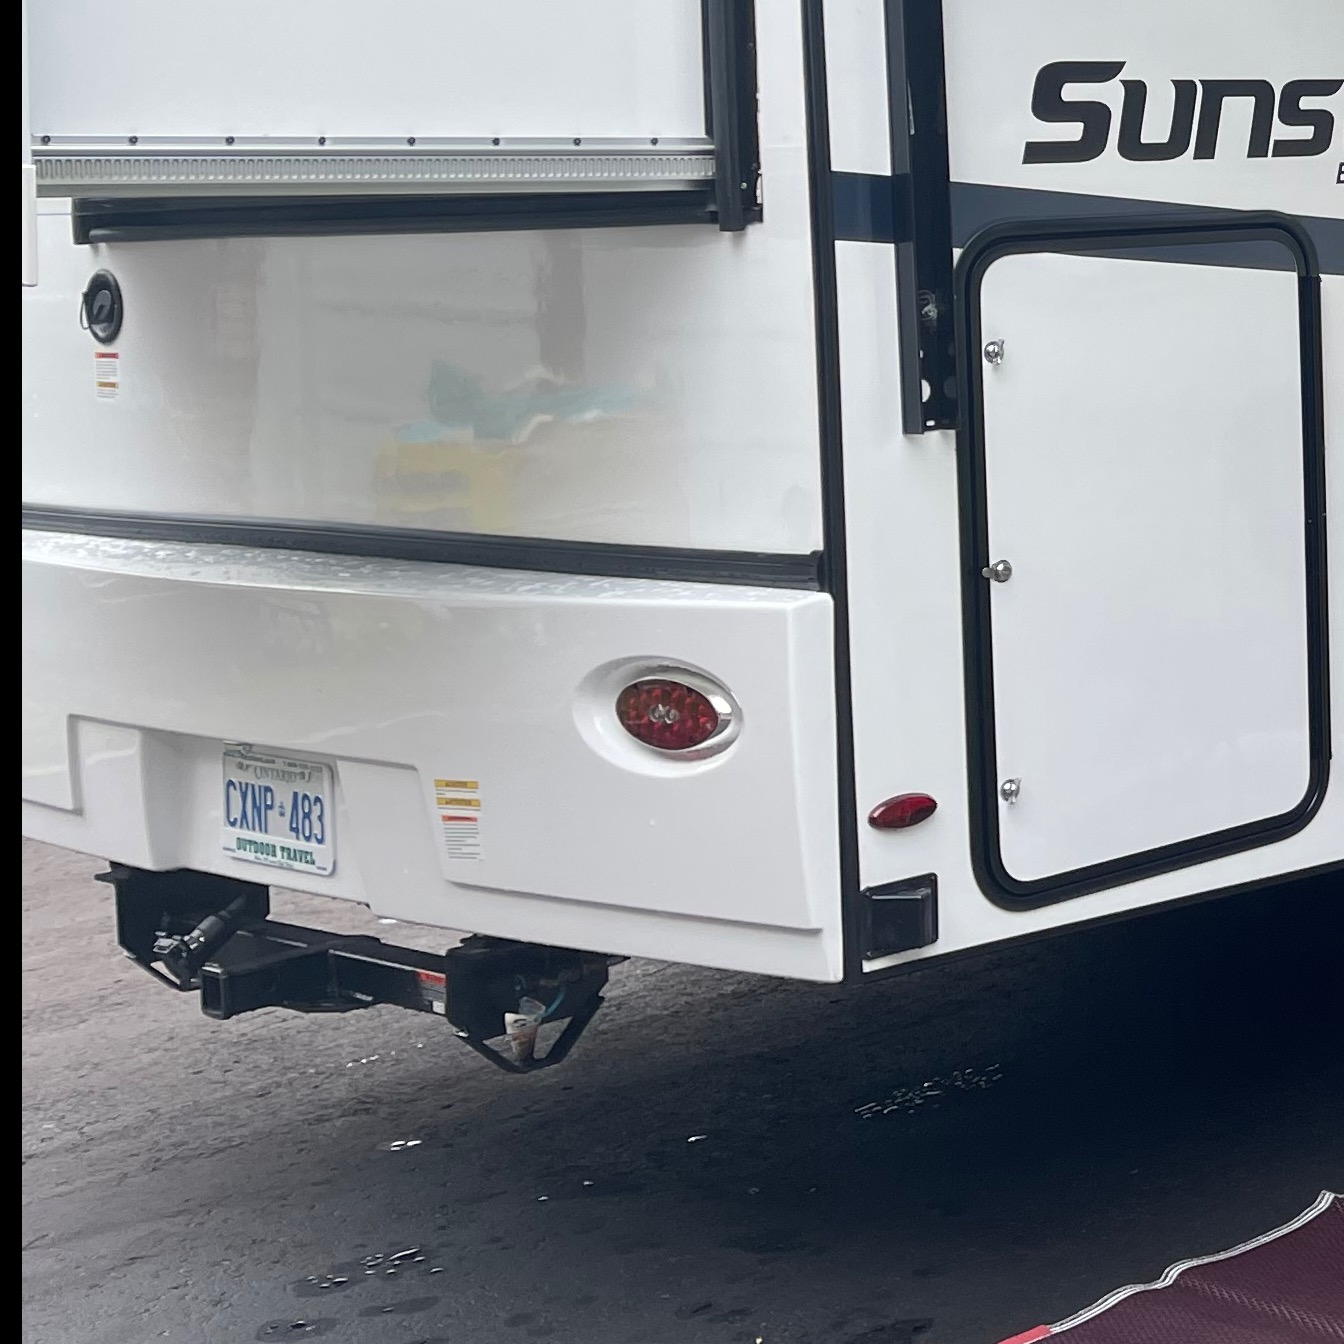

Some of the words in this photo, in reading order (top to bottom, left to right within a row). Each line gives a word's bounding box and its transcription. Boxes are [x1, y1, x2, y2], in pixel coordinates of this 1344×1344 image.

[226, 779, 274, 834] CXNP
[290, 791, 324, 844] 483
[236, 837, 277, 857] OUTDOOR
[280, 846, 315, 865] TRAVEL
